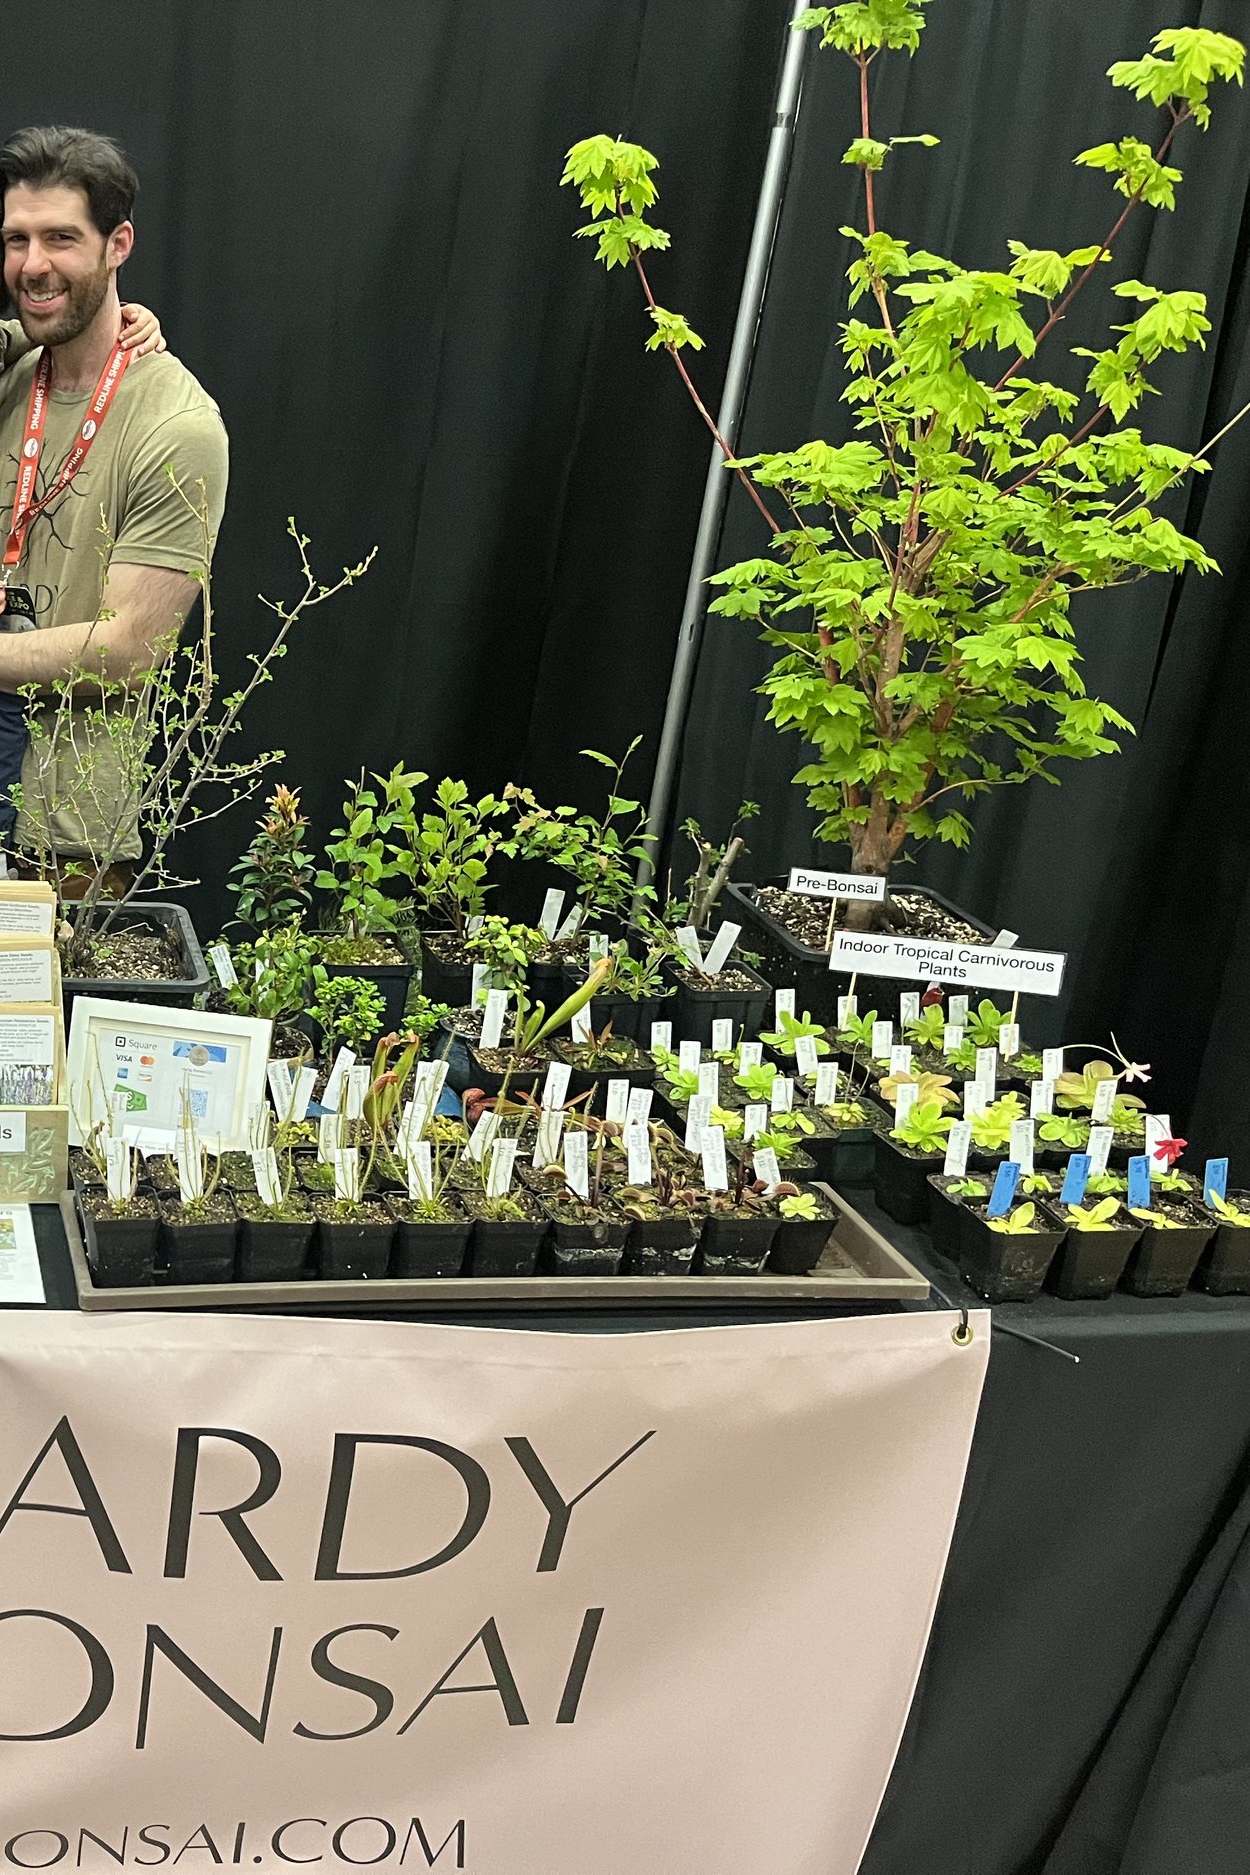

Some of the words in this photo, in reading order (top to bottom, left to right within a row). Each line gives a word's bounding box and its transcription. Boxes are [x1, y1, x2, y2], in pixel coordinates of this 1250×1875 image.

[30, 388, 45, 430] SHIPPING
[93, 376, 115, 414] REDLINE
[19, 465, 32, 503] REDLINE
[60, 447, 84, 487] SHIPPING
[796, 875, 878, 895] Pre-Bonsai
[839, 938, 889, 954] Indoor
[893, 943, 953, 962] Tropical
[958, 950, 1055, 972] Carnivorous
[918, 961, 967, 978] Plants
[116, 1053, 133, 1063] VISA
[129, 1039, 157, 1051] Square
